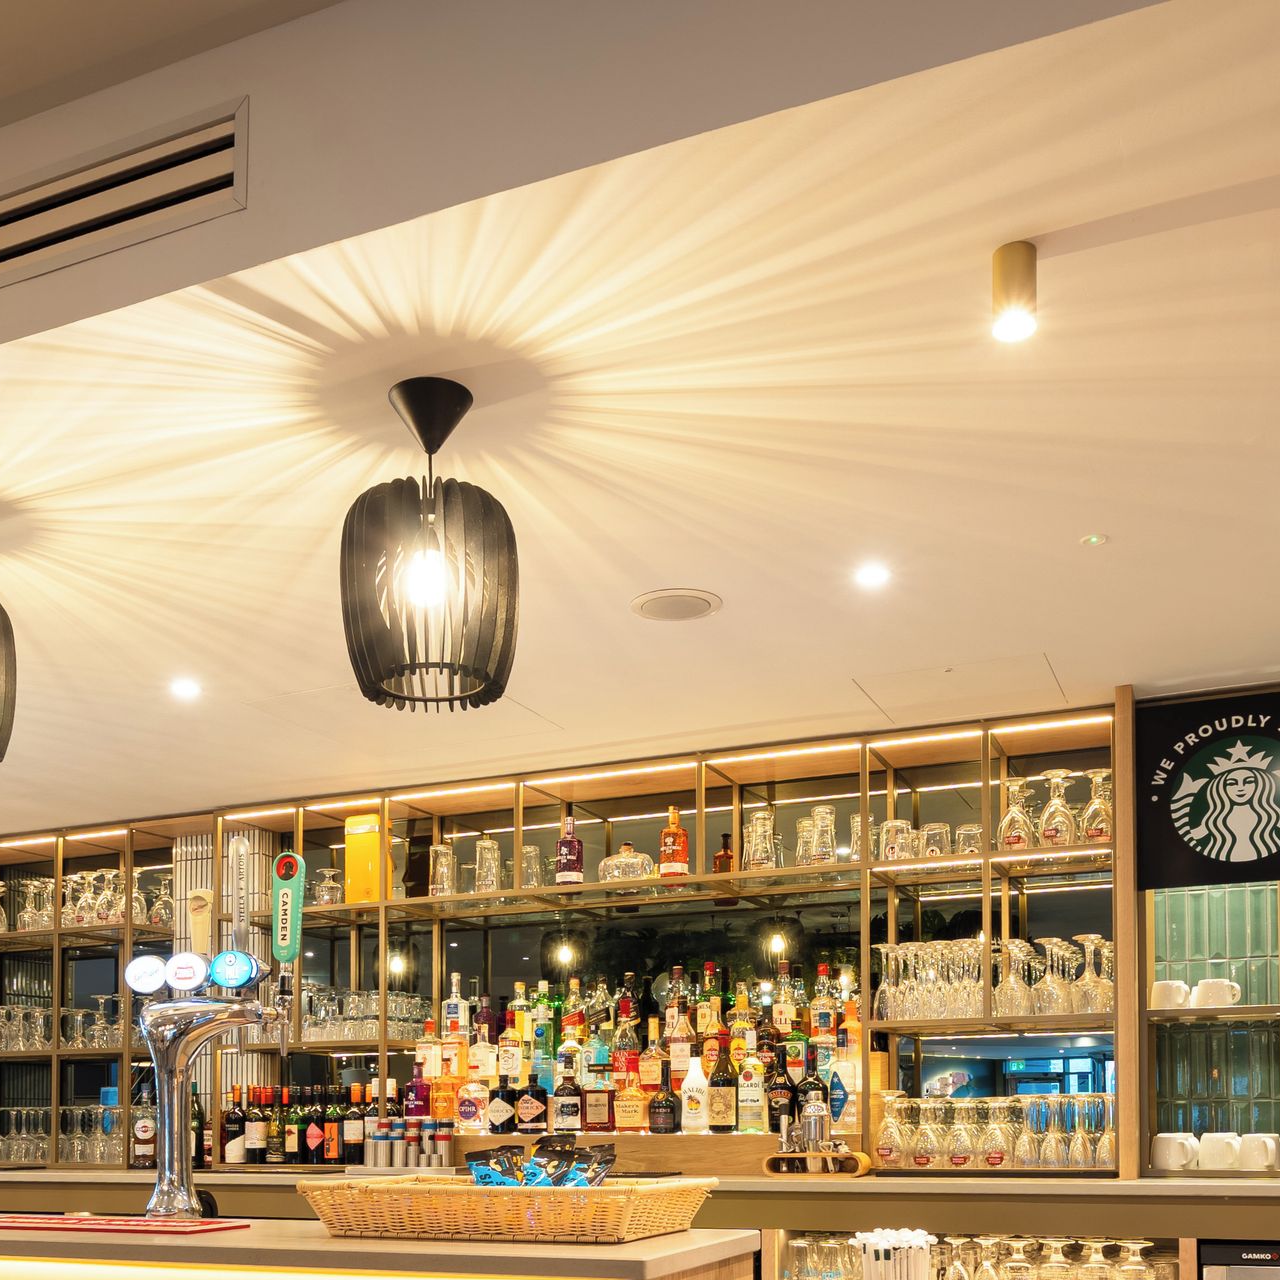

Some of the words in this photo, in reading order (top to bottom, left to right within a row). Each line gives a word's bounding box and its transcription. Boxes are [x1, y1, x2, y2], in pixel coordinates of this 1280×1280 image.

[1151, 758, 1175, 786] WE
[1173, 714, 1272, 755] PROUDLY
[280, 892, 289, 941] CAMDEN
[739, 1081, 760, 1089] ACARDÍ
